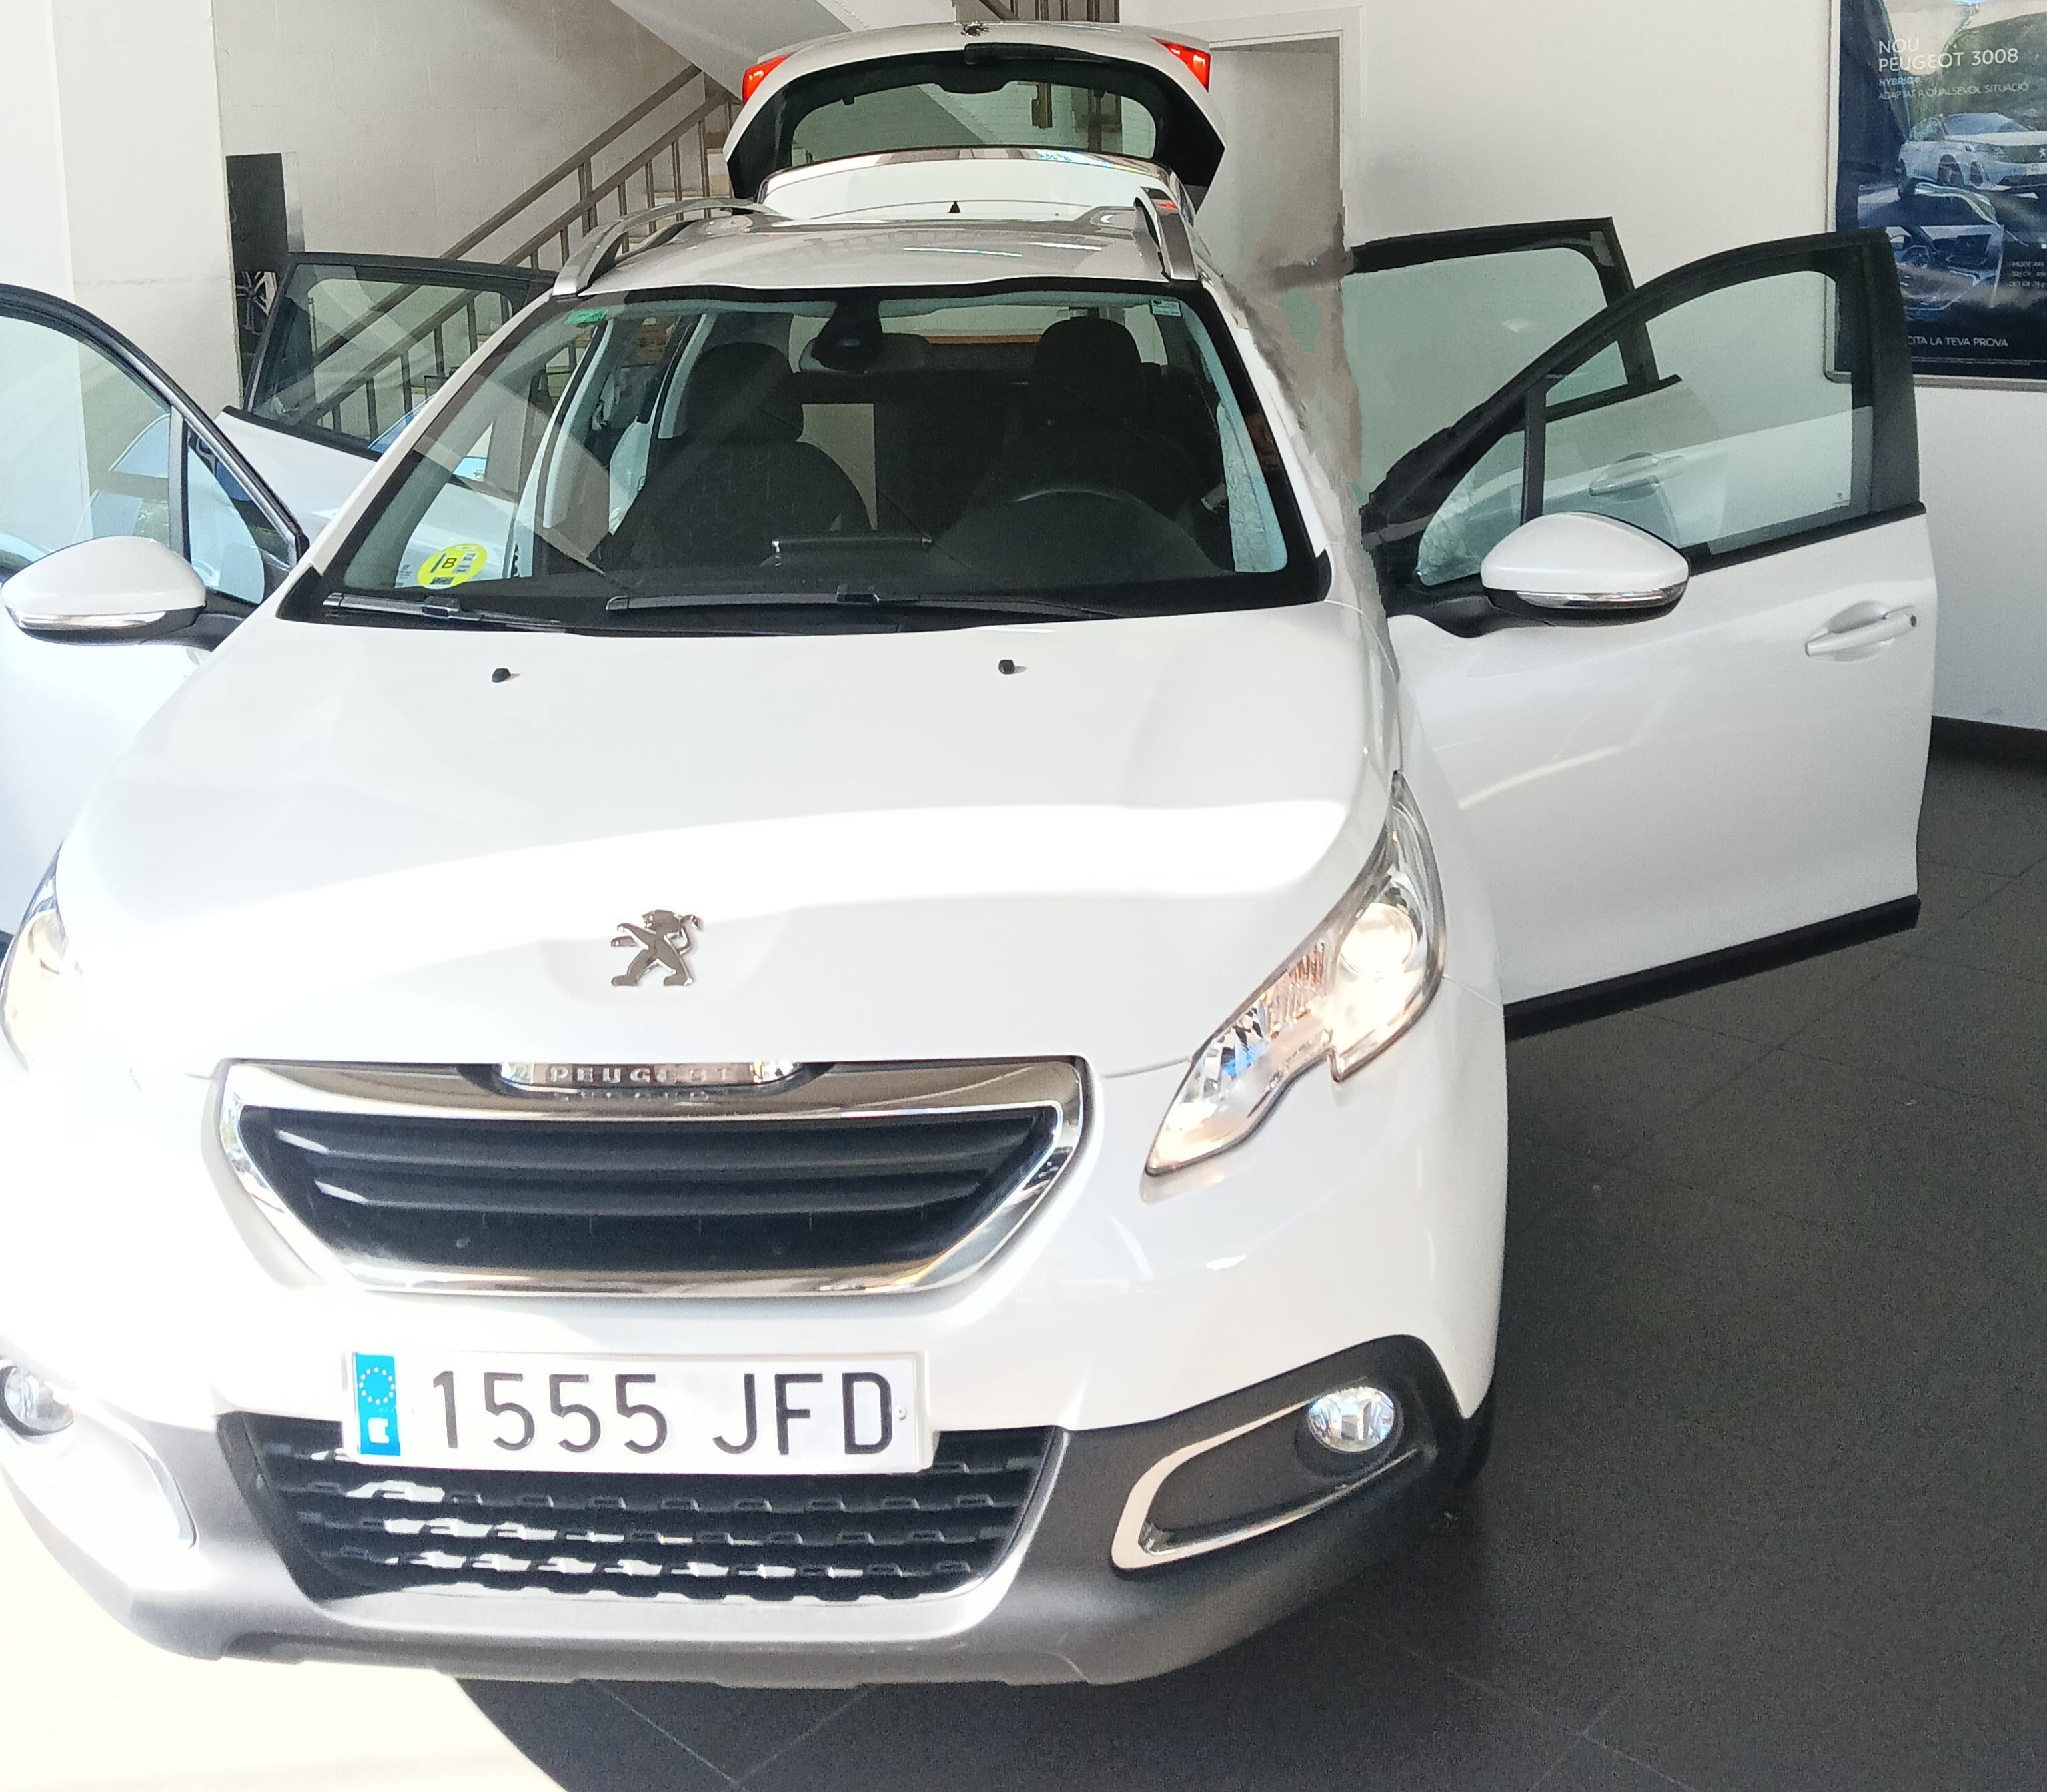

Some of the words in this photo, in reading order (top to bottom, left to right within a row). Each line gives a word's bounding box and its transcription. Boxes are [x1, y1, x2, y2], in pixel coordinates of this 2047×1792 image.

[1878, 38, 1920, 54] NOU
[1878, 52, 1965, 72] PEUGEOT
[1971, 48, 2019, 66] 3008
[1930, 337, 1943, 346] LA
[1946, 337, 1970, 346] TEVA
[1972, 337, 2008, 347] PROVA
[441, 558, 457, 569] B
[432, 1370, 668, 1454] 1555
[712, 1371, 894, 1455] JFD
